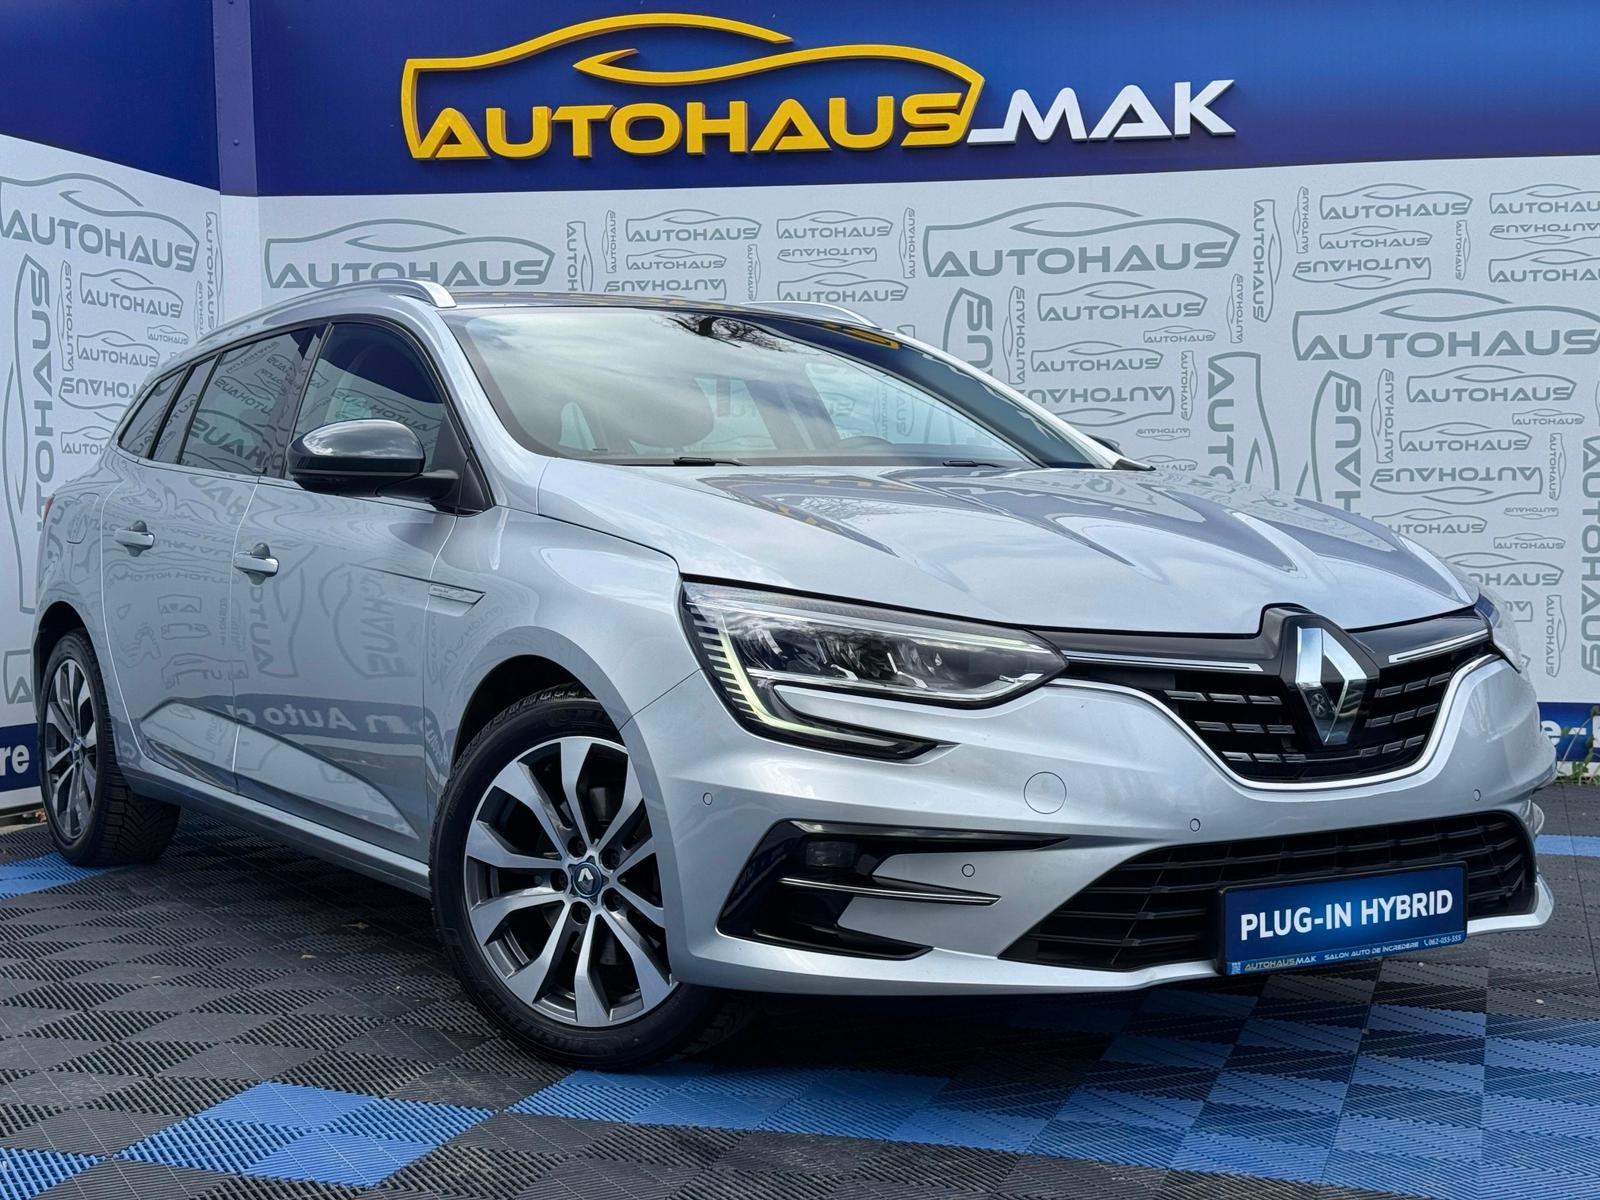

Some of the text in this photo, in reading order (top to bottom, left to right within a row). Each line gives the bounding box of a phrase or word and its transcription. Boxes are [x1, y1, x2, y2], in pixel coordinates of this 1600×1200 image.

[411, 92, 966, 160] AUTOHAUS
[1322, 202, 1470, 220] AUTOHAUS
[1302, 188, 1310, 253] AUTOHAUS
[1, 209, 197, 272] AUTOHAUS
[628, 227, 758, 243] AUTOHAUS
[778, 226, 891, 239] AUTOHAUS
[609, 211, 617, 273] AUTOHAUS
[909, 208, 917, 278] AUTOHAUS
[1321, 237, 1429, 250] AUTOHAUS
[1455, 220, 1463, 280] AUTOHAUS
[780, 247, 876, 257] AUTOHAUS
[928, 241, 1232, 278] AUTOHAUS
[1253, 201, 1266, 321] AUTOHAUS
[628, 258, 725, 271] AUTOHAUS
[1297, 257, 1429, 273] AUTOHAUS
[1491, 267, 1600, 284] AUTOHA
[607, 279, 724, 294] AUTOHAUS
[781, 289, 908, 302] AUTOHAUS
[82, 287, 183, 319] AUTOHAUS
[1040, 302, 1205, 322] AUTOHAUS
[1235, 275, 1244, 343] AUTOHAUS
[65, 262, 74, 370] AUTOHAUS
[149, 333, 190, 345] AUTOHAUS
[1015, 288, 1026, 384] AUTOHAUS
[1145, 334, 1215, 344] AUTOHAUS
[1300, 329, 1600, 362] AUTOHAUS
[78, 346, 158, 368] AUTOHAUS
[1034, 357, 1161, 373] AUTOHAUS
[1180, 351, 1189, 419] AUTOHAUS
[1020, 386, 1171, 404] AUTOHAU
[1409, 387, 1574, 403] AUTOHAUS
[1384, 371, 1394, 462] AUTOHAUS
[1513, 417, 1583, 426] AUTOHAUS
[1137, 428, 1190, 436] AUTOHAUS
[1401, 439, 1530, 452] AUTOHAUS
[1375, 467, 1540, 483] AUTOHAUS
[1549, 433, 1557, 499] AUTOHAUS
[1495, 542, 1564, 550] AUTOHAUS
[1546, 595, 1555, 677] AUTOHAUS
[1240, 889, 1453, 941] PLUG-IN HYBRID
[1324, 951, 1349, 961] SALON
[1351, 948, 1371, 957] AUTO
[1372, 946, 1381, 954] DE
